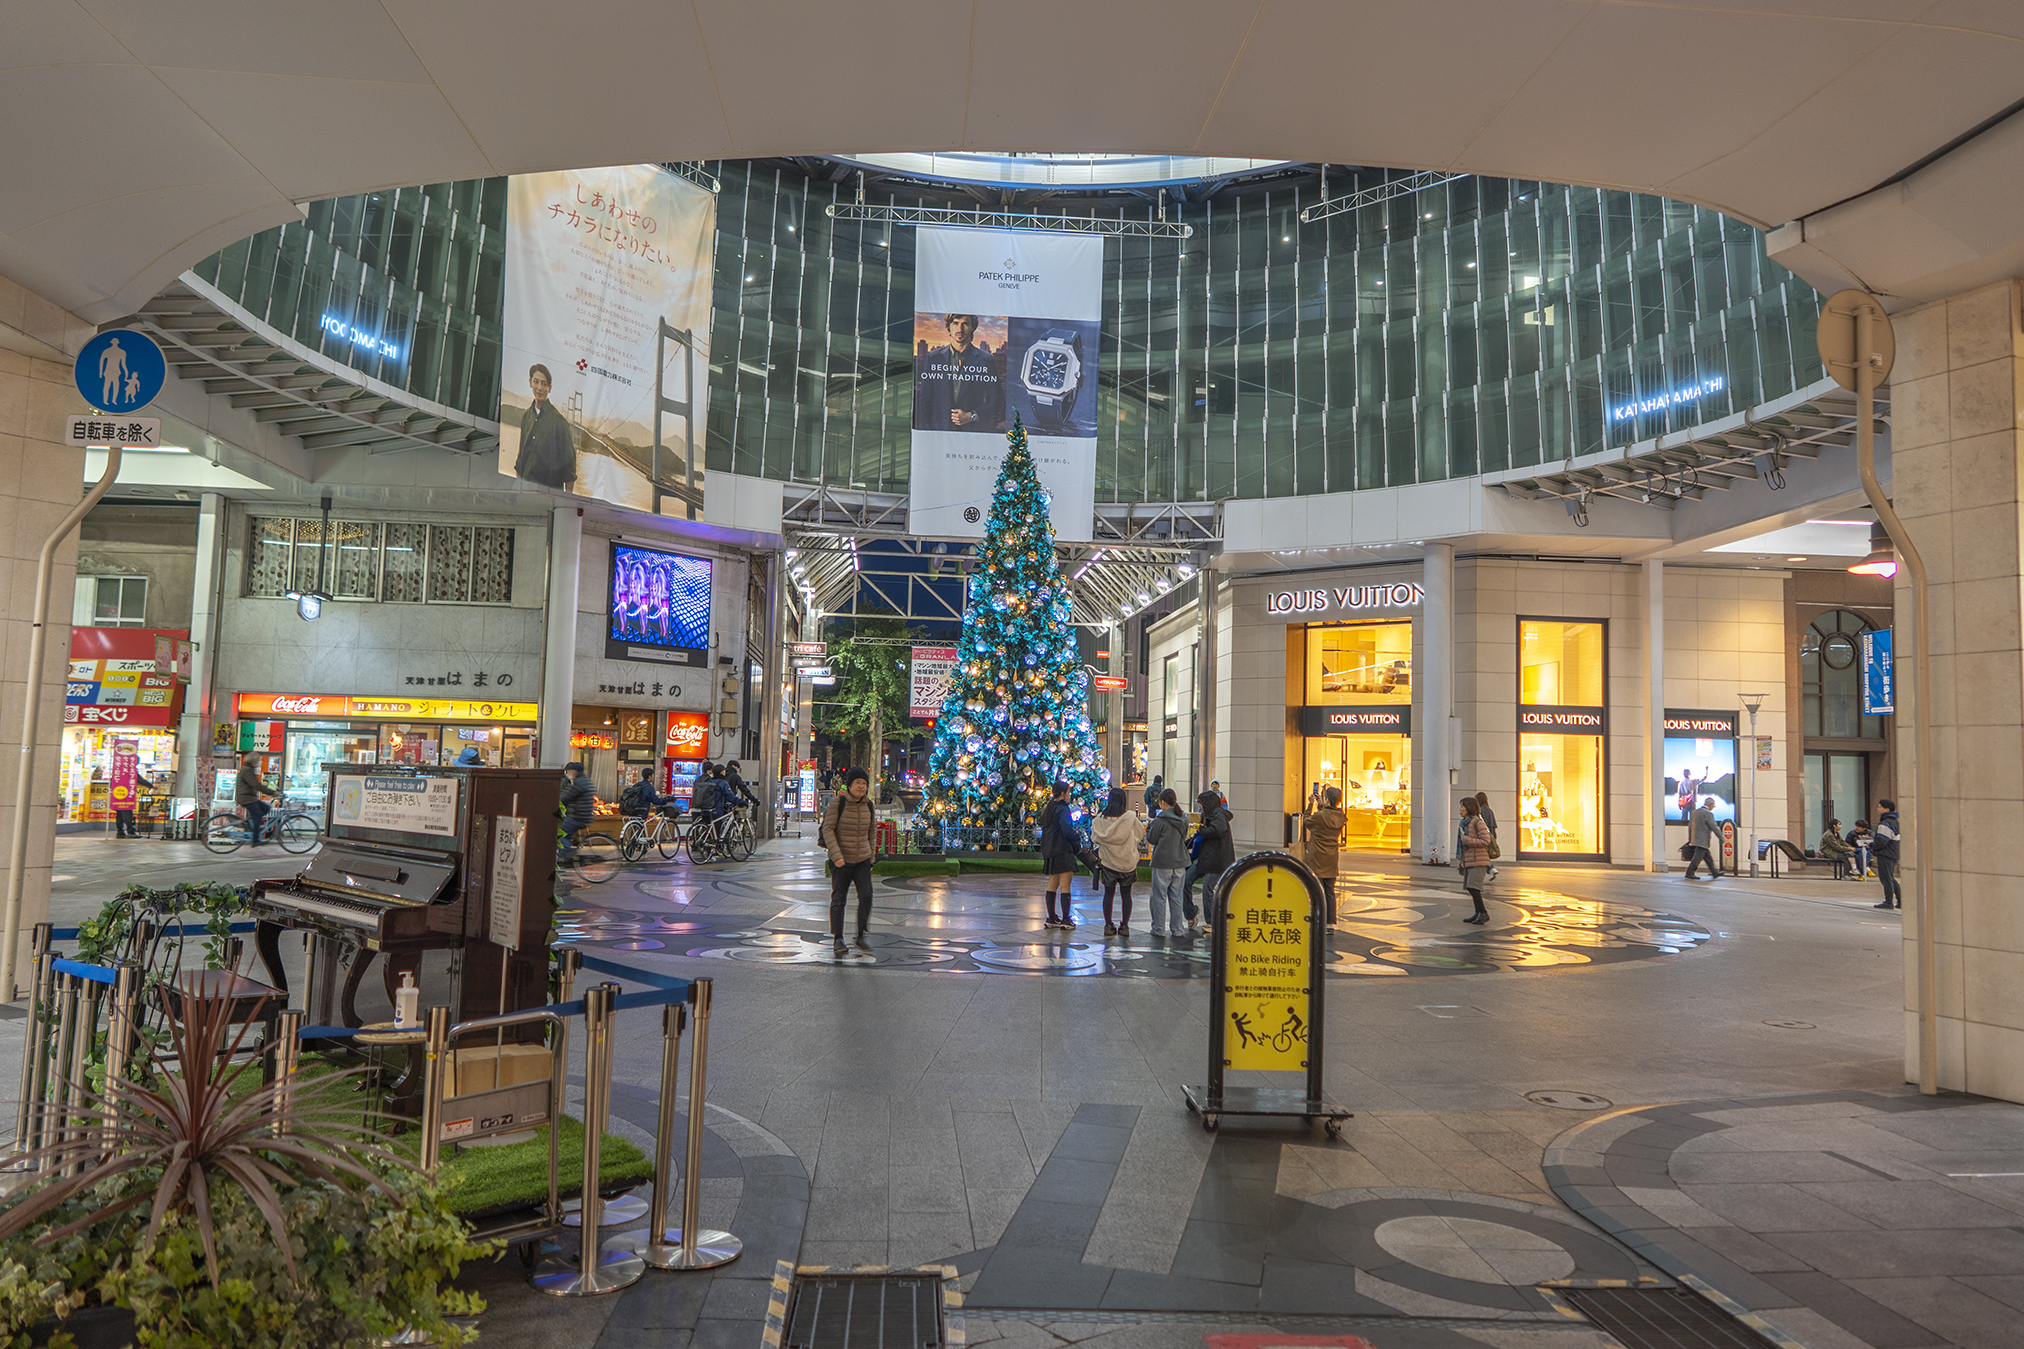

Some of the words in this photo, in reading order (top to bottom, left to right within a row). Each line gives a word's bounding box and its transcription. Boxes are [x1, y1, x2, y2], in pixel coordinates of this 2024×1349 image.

[577, 183, 657, 234] しあわせの
[547, 203, 676, 273] チカラになりたい。
[978, 271, 1004, 281] PATEK
[1005, 273, 1040, 283] PHILIPPE
[931, 363, 960, 372] BEGIN
[963, 365, 988, 373] YOUR
[590, 365, 632, 387] 四国電力株式会社
[921, 372, 944, 380] OWN
[947, 373, 998, 383] TRADITION
[73, 421, 153, 442] 自転車を除く
[1267, 589, 1328, 614] LOUIS
[1333, 582, 1425, 609] VUITTON
[804, 644, 822, 653] café
[145, 677, 170, 687] BIG
[914, 676, 939, 685] 話題の
[914, 685, 950, 697] マシン
[271, 696, 322, 713] Coca-Cola
[357, 703, 406, 712] HAMANO
[419, 701, 538, 718] ジェラート&クレー
[82, 707, 128, 722] 宝くじ
[1331, 713, 1357, 725] LOUIS
[1359, 713, 1400, 725] VUITTON
[1522, 713, 1553, 725] LOUIS
[1554, 714, 1601, 726] VUITTON
[1664, 719, 1691, 730] LOUIS
[1691, 720, 1732, 731] VUITTON
[669, 725, 703, 741] Coca-Cola
[374, 780, 387, 789] Please
[499, 847, 517, 865] ピアノ
[1246, 908, 1293, 925] 自転車
[1236, 927, 1301, 945] 乗入危険
[1235, 954, 1249, 963] No
[1250, 954, 1270, 964] Bike
[1272, 955, 1301, 967] Riding
[1239, 967, 1296, 977] 禁止骑自行车
[1234, 985, 1301, 993] 歩行者との接触事故防止のため
